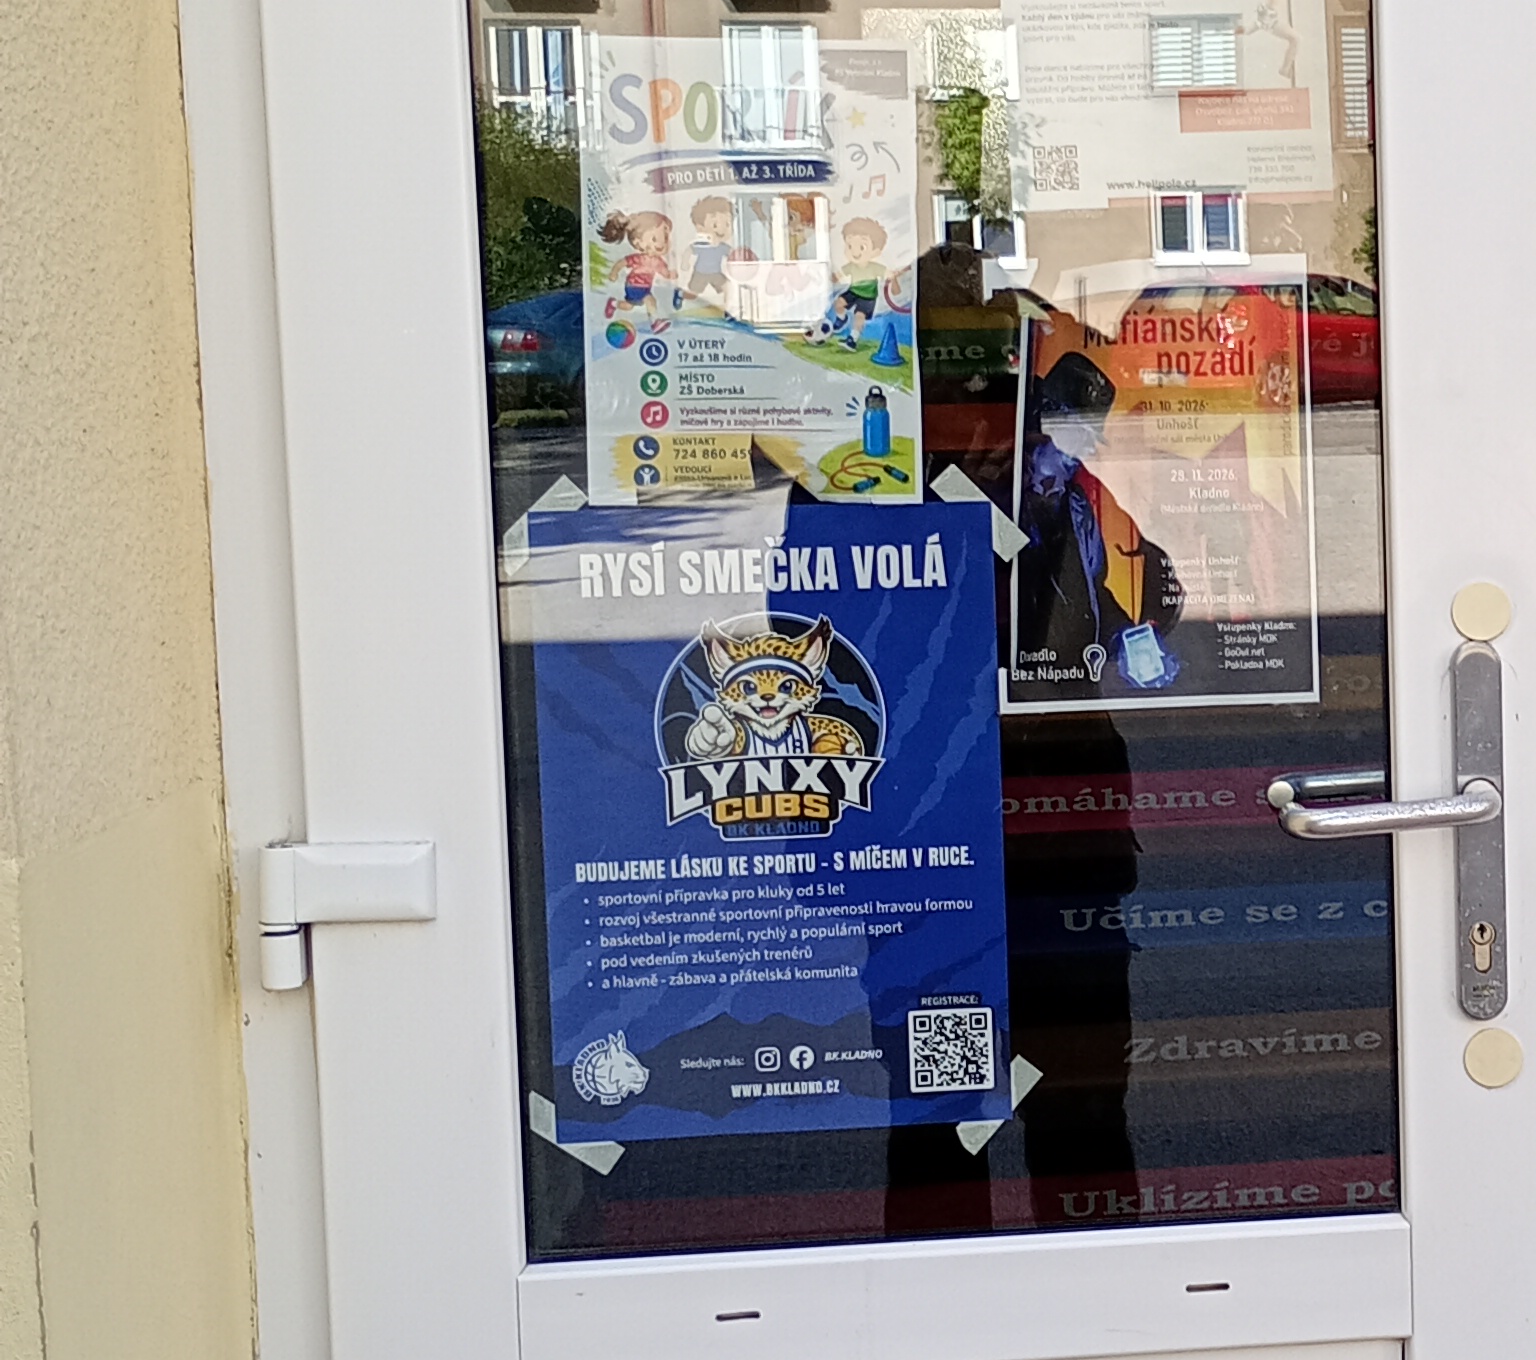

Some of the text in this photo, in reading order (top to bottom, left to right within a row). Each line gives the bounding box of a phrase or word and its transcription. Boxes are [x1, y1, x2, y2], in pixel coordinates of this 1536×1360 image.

[668, 162, 816, 185] PRO DĚTÍ 1. AŽ 3. TŘÍDA
[677, 338, 726, 349] V ÚTERÝ
[678, 353, 752, 362] 17 až 18 hodin
[1157, 336, 1256, 388] pozadí
[679, 372, 715, 383] MÍSTO
[679, 386, 745, 395] ZŠ Doberská
[673, 437, 716, 446] KONTAKT
[673, 449, 727, 460] 724 860
[1189, 487, 1230, 499] Kladno
[580, 532, 947, 598] RYSÍ SMEČKA VOLÁ
[1012, 664, 1085, 683] Bez Nápadu
[668, 758, 873, 818] LYNXY
[1001, 786, 1237, 814] omáhame
[715, 793, 830, 823] CUBS
[727, 820, 820, 837] BK KLADNO
[575, 844, 975, 883] BUDUJEME LÁSKU KE SPORTU S MÍČEM V RUCE.
[598, 882, 845, 908] sportovní přípravka pro kluky od 5 let
[599, 898, 973, 928] rozvoj všestranné sportovní připravenosti hravou formou
[1059, 901, 1345, 933] Učíme se z
[600, 921, 903, 948] basketbal je moderní, rychlý a populární sport
[601, 944, 813, 971] pod vedením zkušených trenérů
[602, 965, 858, 989] a hlavně zábava a přátelská komunita
[921, 995, 979, 1006] REGISTRACE:
[1124, 1026, 1382, 1064] Zdravíme
[680, 1056, 745, 1070] Sledujte nás:
[731, 1080, 840, 1098] WWW.BKKLADNO.CZ
[1058, 1179, 1320, 1219] Uklízíme
